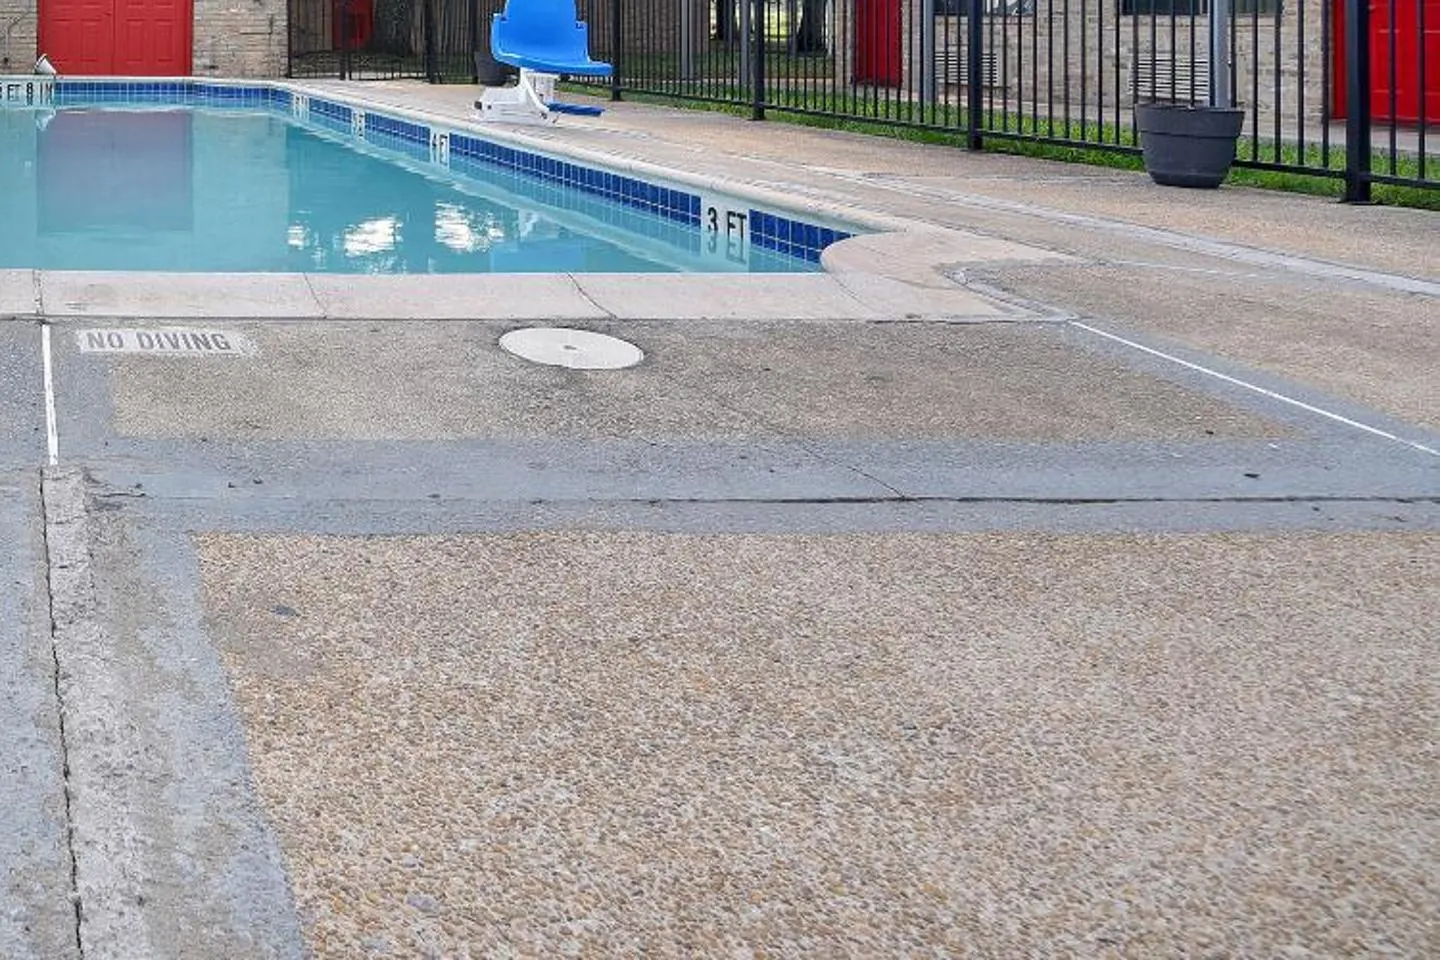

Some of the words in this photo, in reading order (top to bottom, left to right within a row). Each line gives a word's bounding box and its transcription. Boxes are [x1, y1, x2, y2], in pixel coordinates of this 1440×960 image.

[707, 207, 718, 232] 3
[726, 211, 747, 239] FT
[85, 331, 124, 349] NO
[136, 331, 232, 351] DIVING
